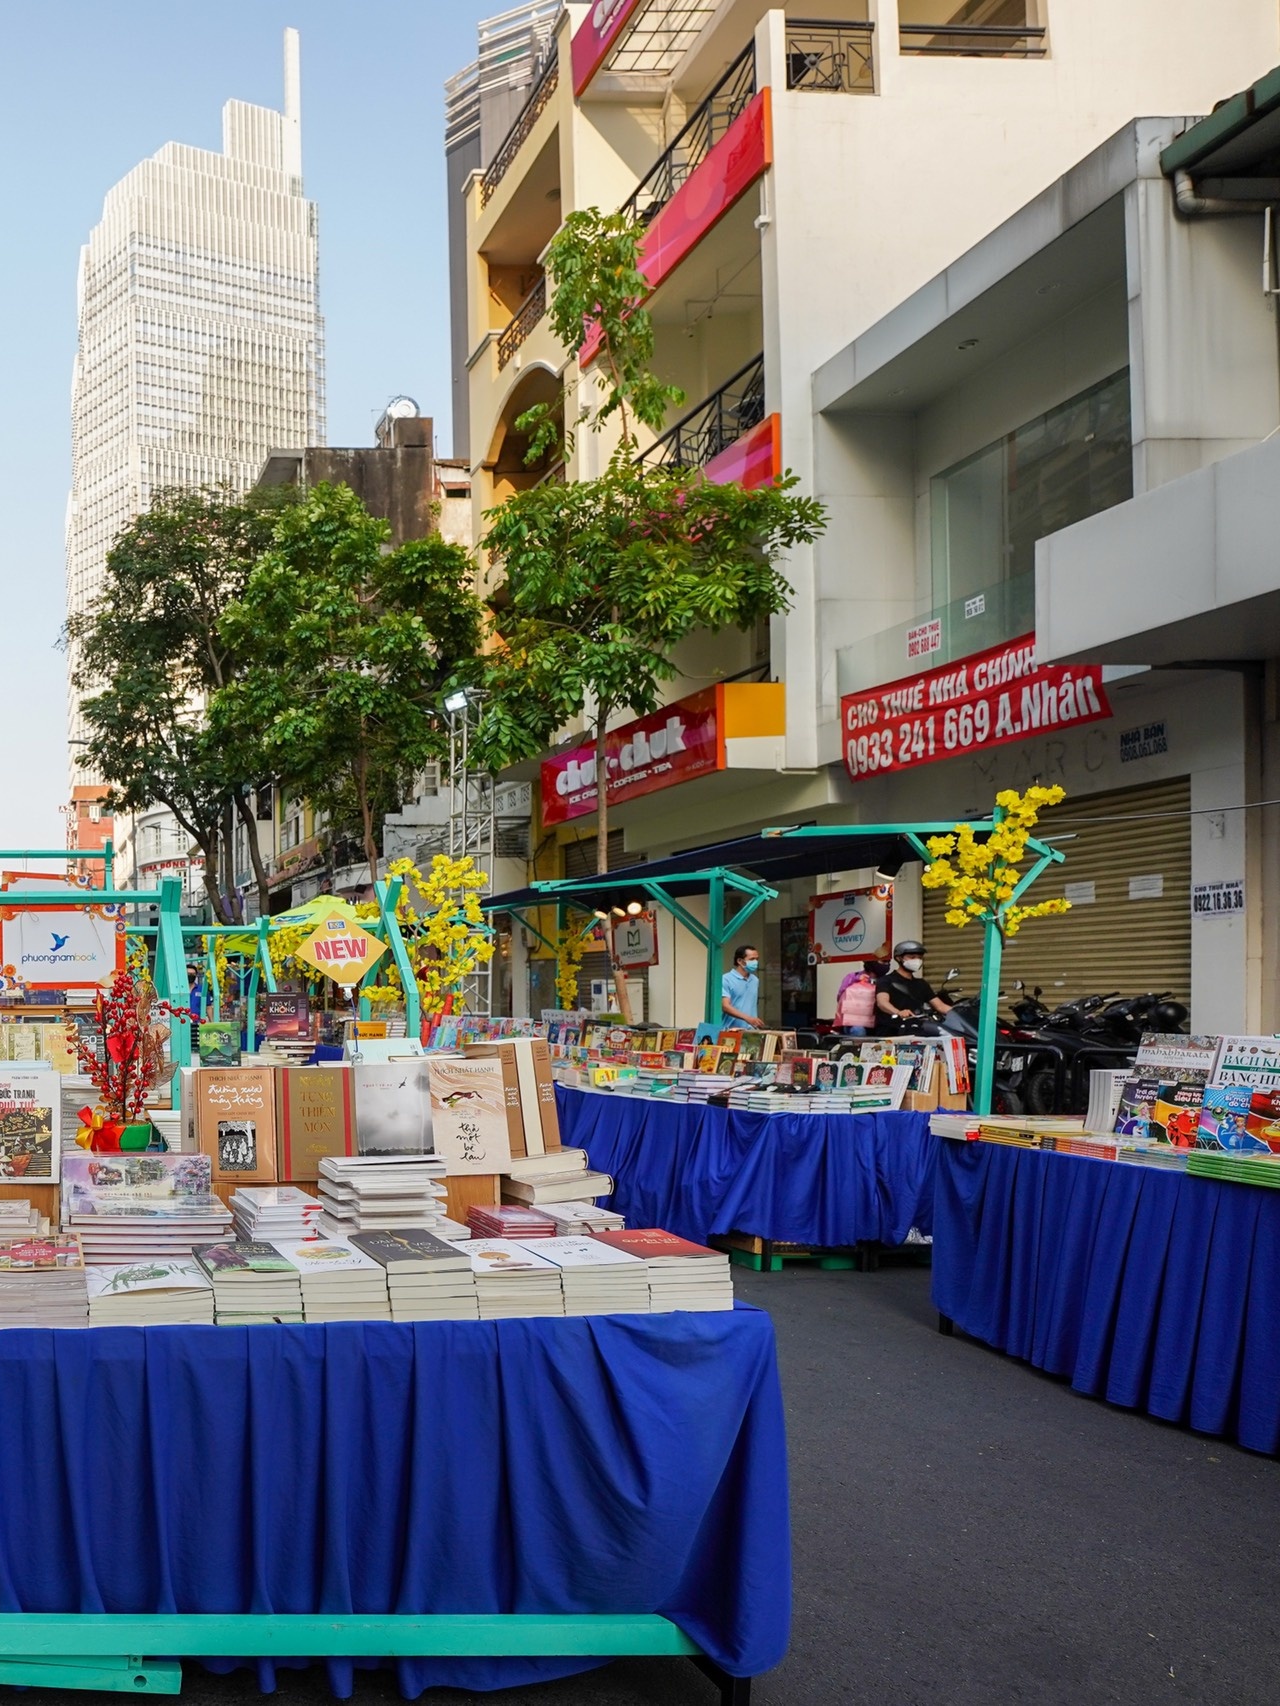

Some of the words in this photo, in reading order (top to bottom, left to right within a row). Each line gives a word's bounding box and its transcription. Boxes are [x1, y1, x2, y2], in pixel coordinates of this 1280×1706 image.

[847, 699, 879, 731] CHO
[881, 682, 924, 720] THUÊ
[928, 664, 969, 707] NHÀ
[973, 645, 1038, 692] CHÍNH
[847, 728, 893, 777] 0933
[899, 717, 936, 763] 241
[943, 699, 990, 750] 669
[995, 672, 1101, 738] A.Nhân
[614, 770, 648, 789] COFFEE
[652, 762, 673, 774] TEA
[1194, 890, 1243, 912] 0922.16.36.36
[314, 937, 369, 961] NEW
[833, 934, 865, 945] TANVIET
[13, 1089, 36, 1099] TRANH
